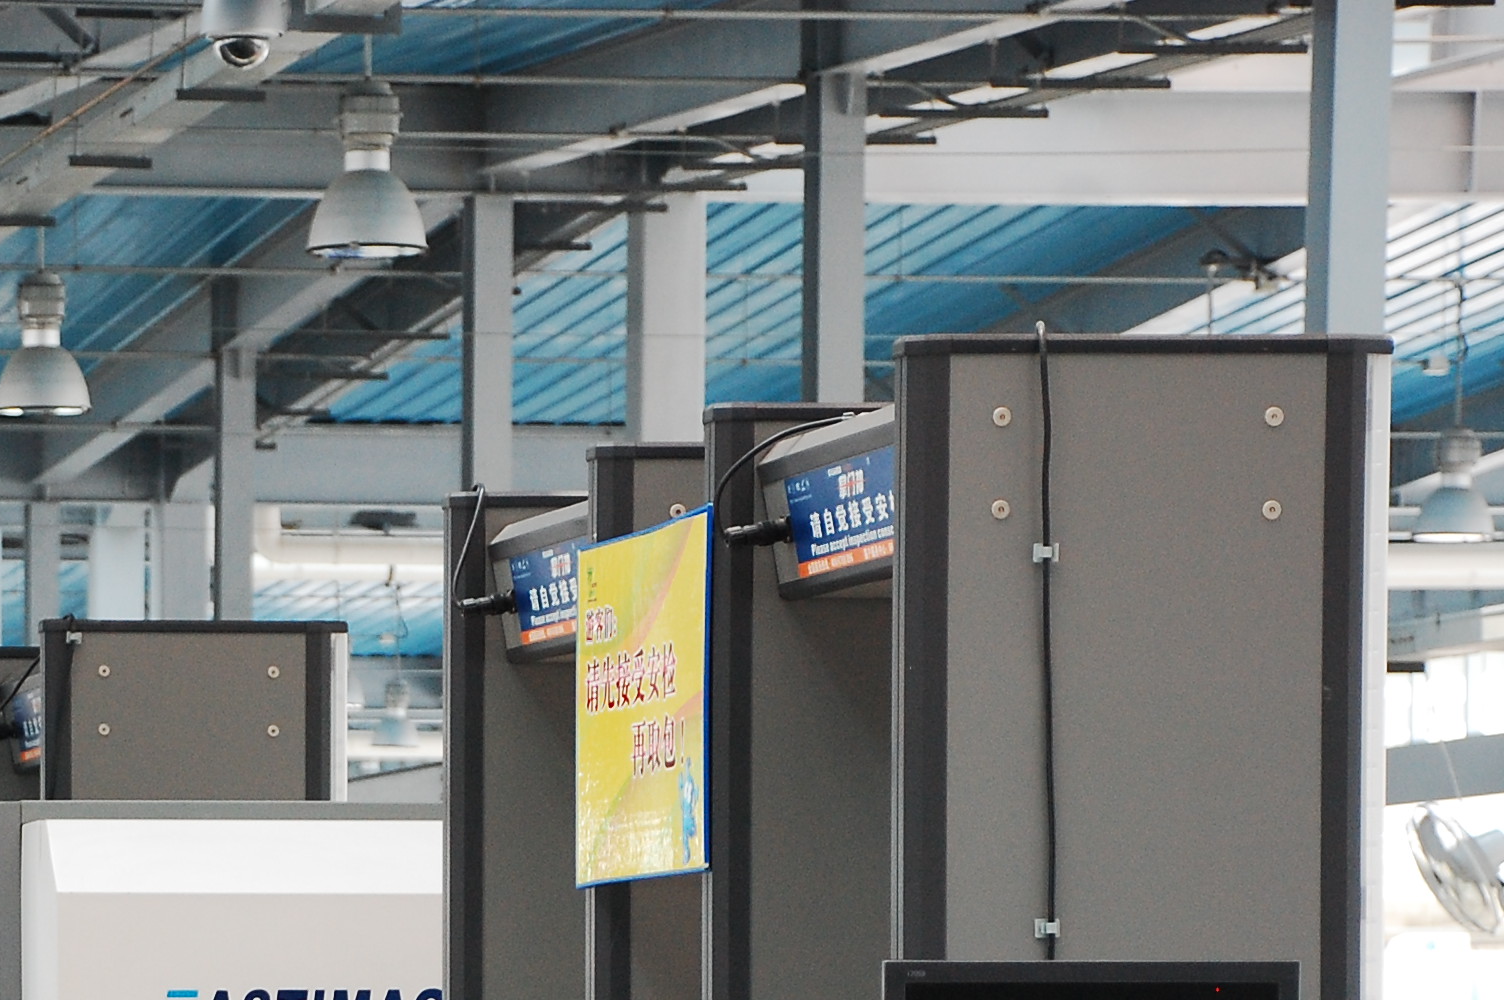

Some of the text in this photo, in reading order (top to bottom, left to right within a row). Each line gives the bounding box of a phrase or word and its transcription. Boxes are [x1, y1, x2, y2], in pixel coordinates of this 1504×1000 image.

[586, 643, 677, 714] 请先接受安检
